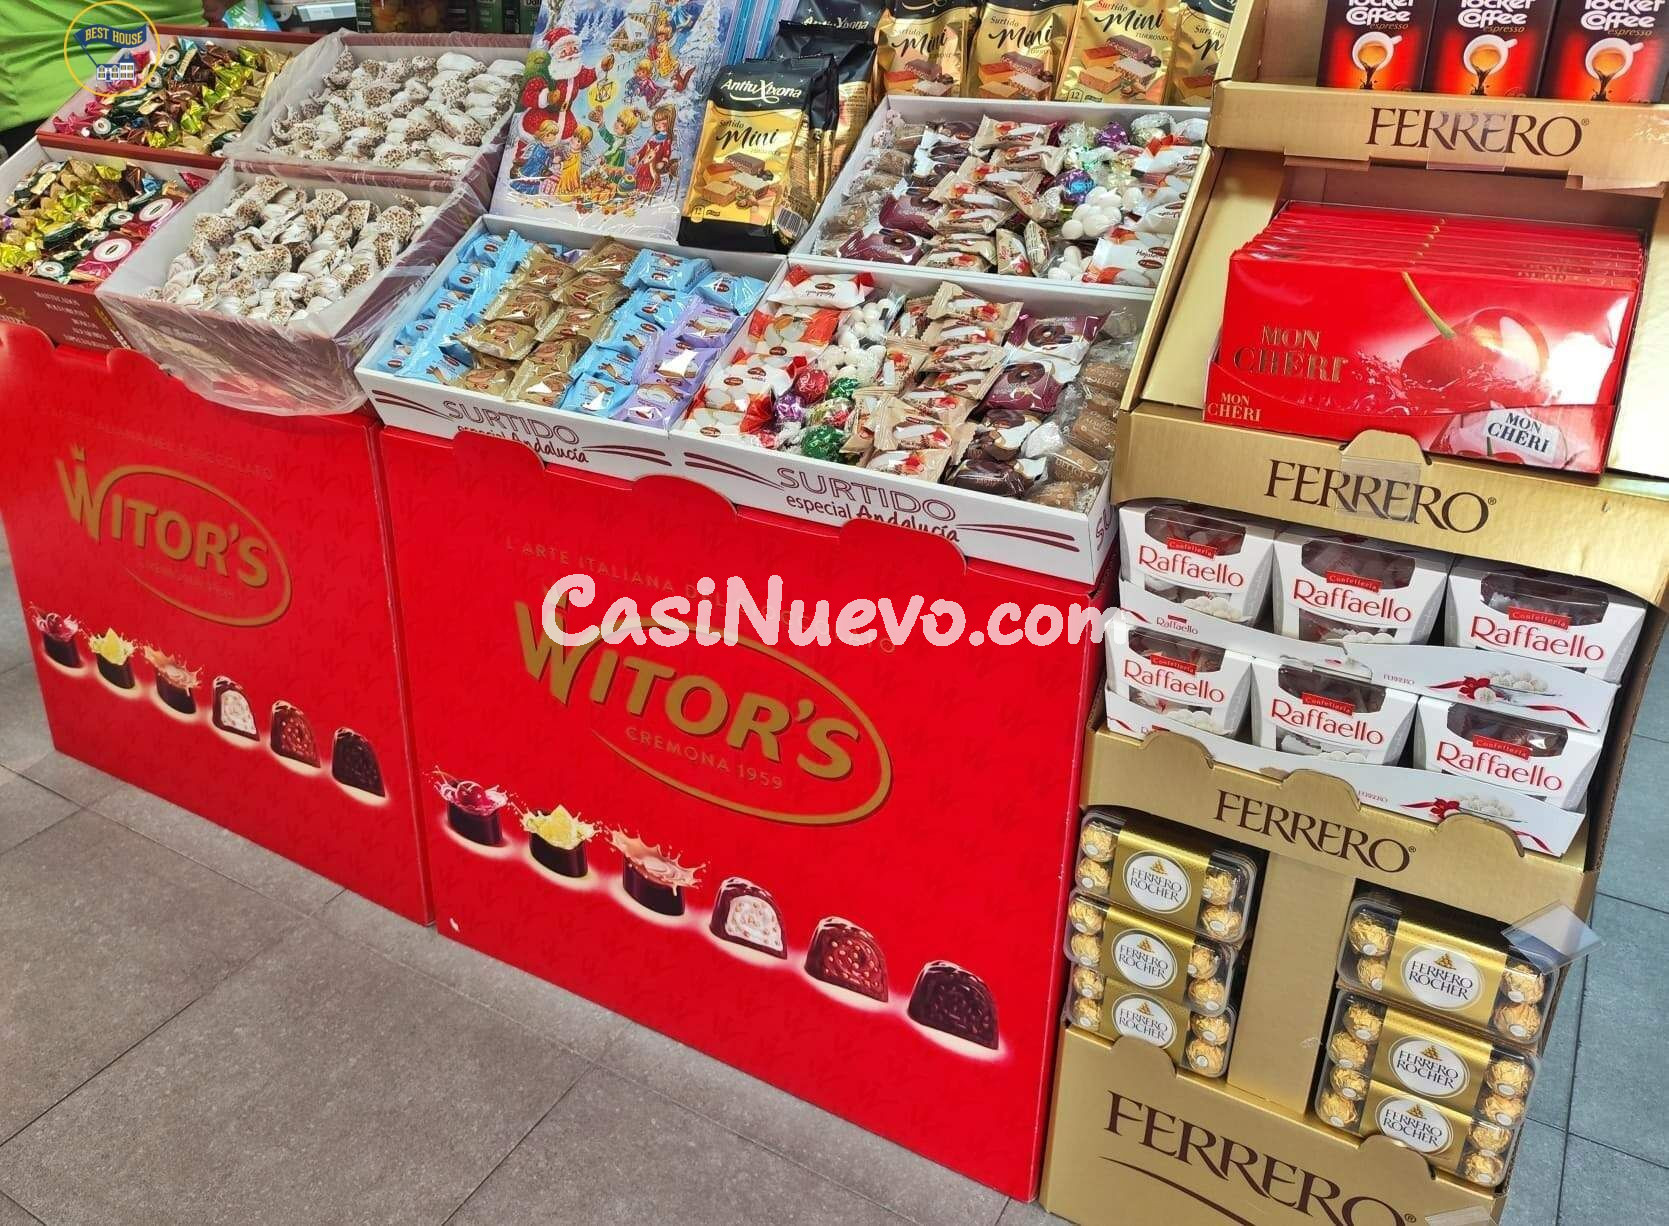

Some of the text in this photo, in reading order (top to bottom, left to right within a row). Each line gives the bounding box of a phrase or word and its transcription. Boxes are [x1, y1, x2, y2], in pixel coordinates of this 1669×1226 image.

[1094, 10, 1164, 33] Mini
[1346, 7, 1411, 26] Coffee
[1458, 9, 1528, 28] Coffee
[1483, 26, 1525, 34] espresso
[1581, 10, 1656, 31] Coffee
[988, 25, 1053, 49] Mini
[1608, 28, 1653, 37] espresso
[716, 127, 780, 150] Mini
[1366, 107, 1582, 156] FERRERO
[1262, 325, 1320, 351] MON
[1220, 391, 1250, 406] MON
[443, 400, 579, 445] SURTIDO
[1506, 413, 1542, 434] MON
[777, 467, 956, 521] SURTIDO
[786, 494, 851, 518] especial
[1264, 459, 1489, 534] FERRERO
[1138, 545, 1244, 587] Raffaello
[1293, 578, 1412, 622] Raffaello
[1156, 616, 1199, 635] Raffaello
[1471, 616, 1605, 661] Raffaello
[1124, 659, 1225, 703] Raffaello
[1271, 698, 1384, 744] Raffaello
[625, 727, 783, 789] CREMONA 1959
[1436, 741, 1562, 791] Raffaello
[1213, 789, 1410, 873] FERRERO
[1129, 877, 1180, 904] ROCHER
[1131, 867, 1183, 893] FERRERO
[1118, 954, 1166, 980] ROCHER
[1120, 945, 1169, 970] FERRERO
[1408, 969, 1469, 1001] ROCHER
[1412, 959, 1473, 989] FERRERO
[1118, 1016, 1166, 1042] ROCHER
[1119, 1007, 1168, 1033] FERRERO
[1396, 1059, 1455, 1090] ROCHER
[1399, 1050, 1459, 1080] FERRERO
[1383, 1117, 1440, 1147] ROCHER
[1385, 1107, 1443, 1137] FERRERO
[1104, 1090, 1404, 1226] FERRERO
